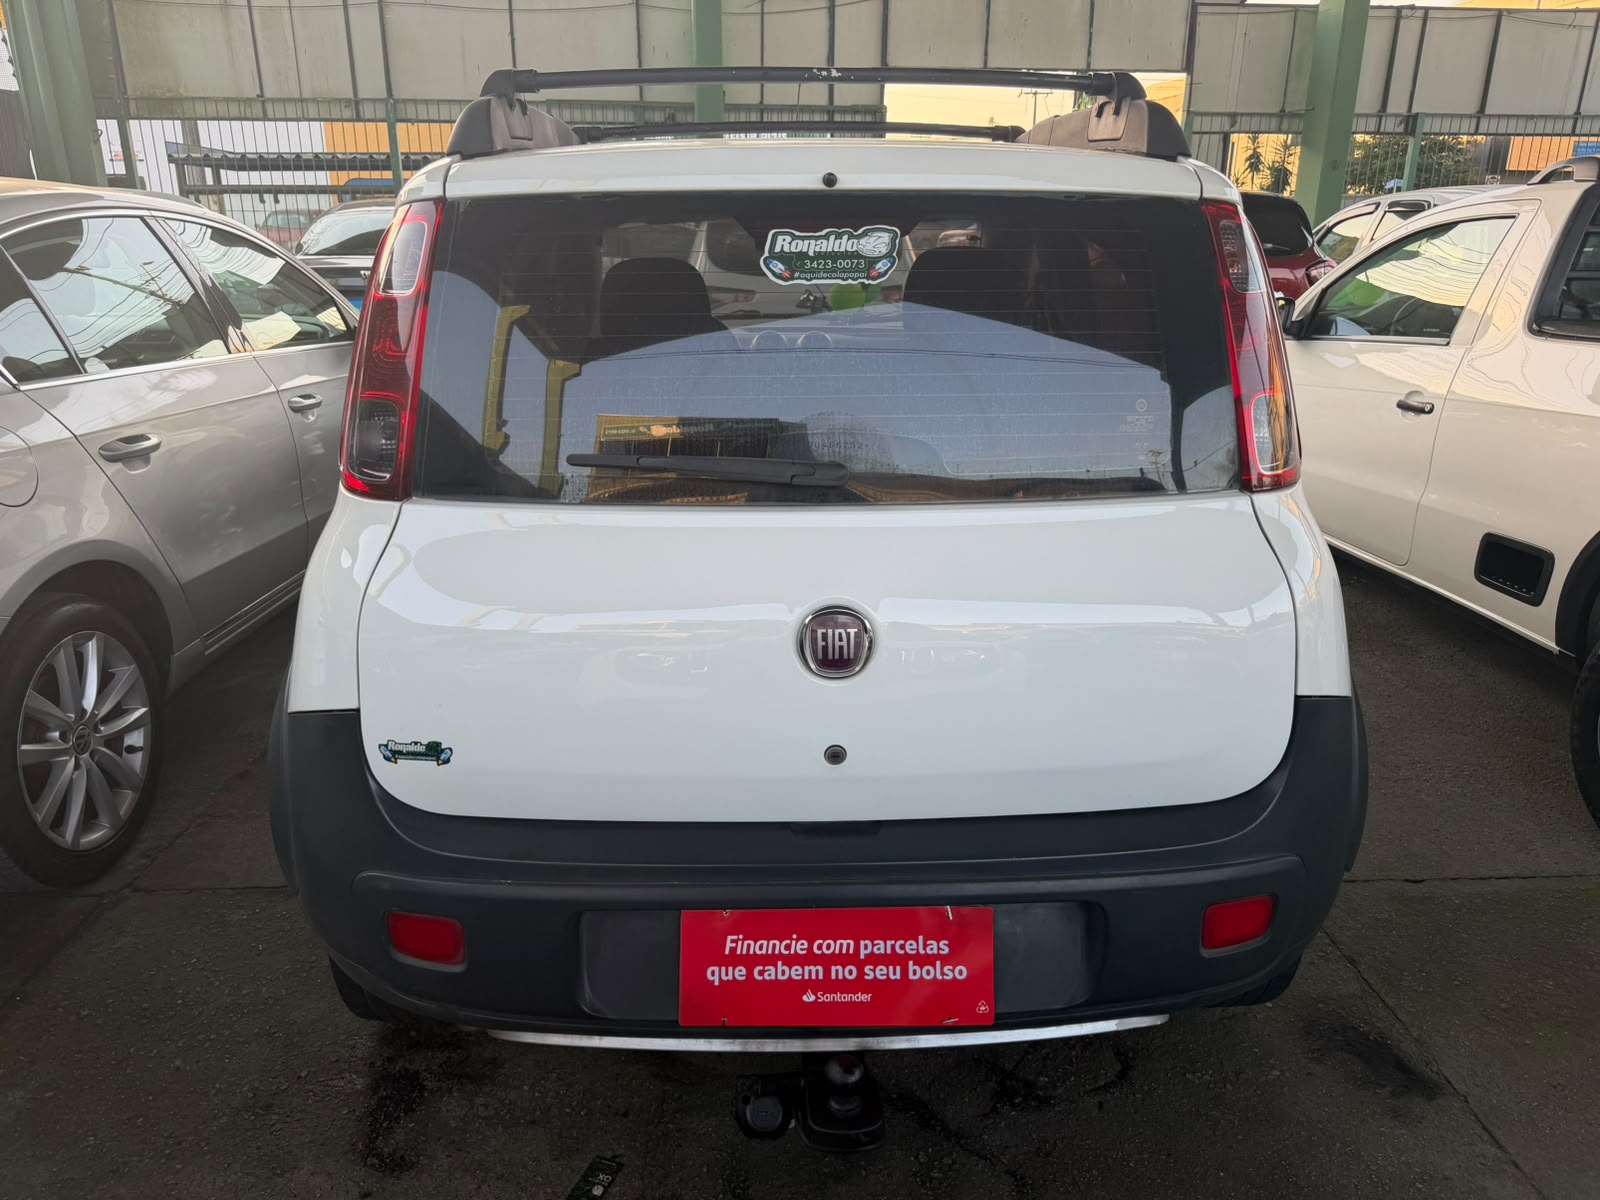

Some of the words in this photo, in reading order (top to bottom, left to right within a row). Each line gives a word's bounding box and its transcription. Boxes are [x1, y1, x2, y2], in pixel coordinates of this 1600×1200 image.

[774, 235, 857, 256] Ronaldo
[804, 260, 865, 269] 3423-0073
[793, 271, 868, 280] #aquidecolapapai
[817, 628, 858, 660] FIAT
[724, 935, 808, 955] Financie
[812, 939, 854, 955] com
[859, 935, 950, 960] parcelas
[706, 965, 747, 986] que
[753, 961, 824, 980] cabem
[830, 965, 858, 980] no
[863, 965, 901, 980] seu
[908, 961, 968, 980] bolso
[816, 991, 872, 1003] Santander
